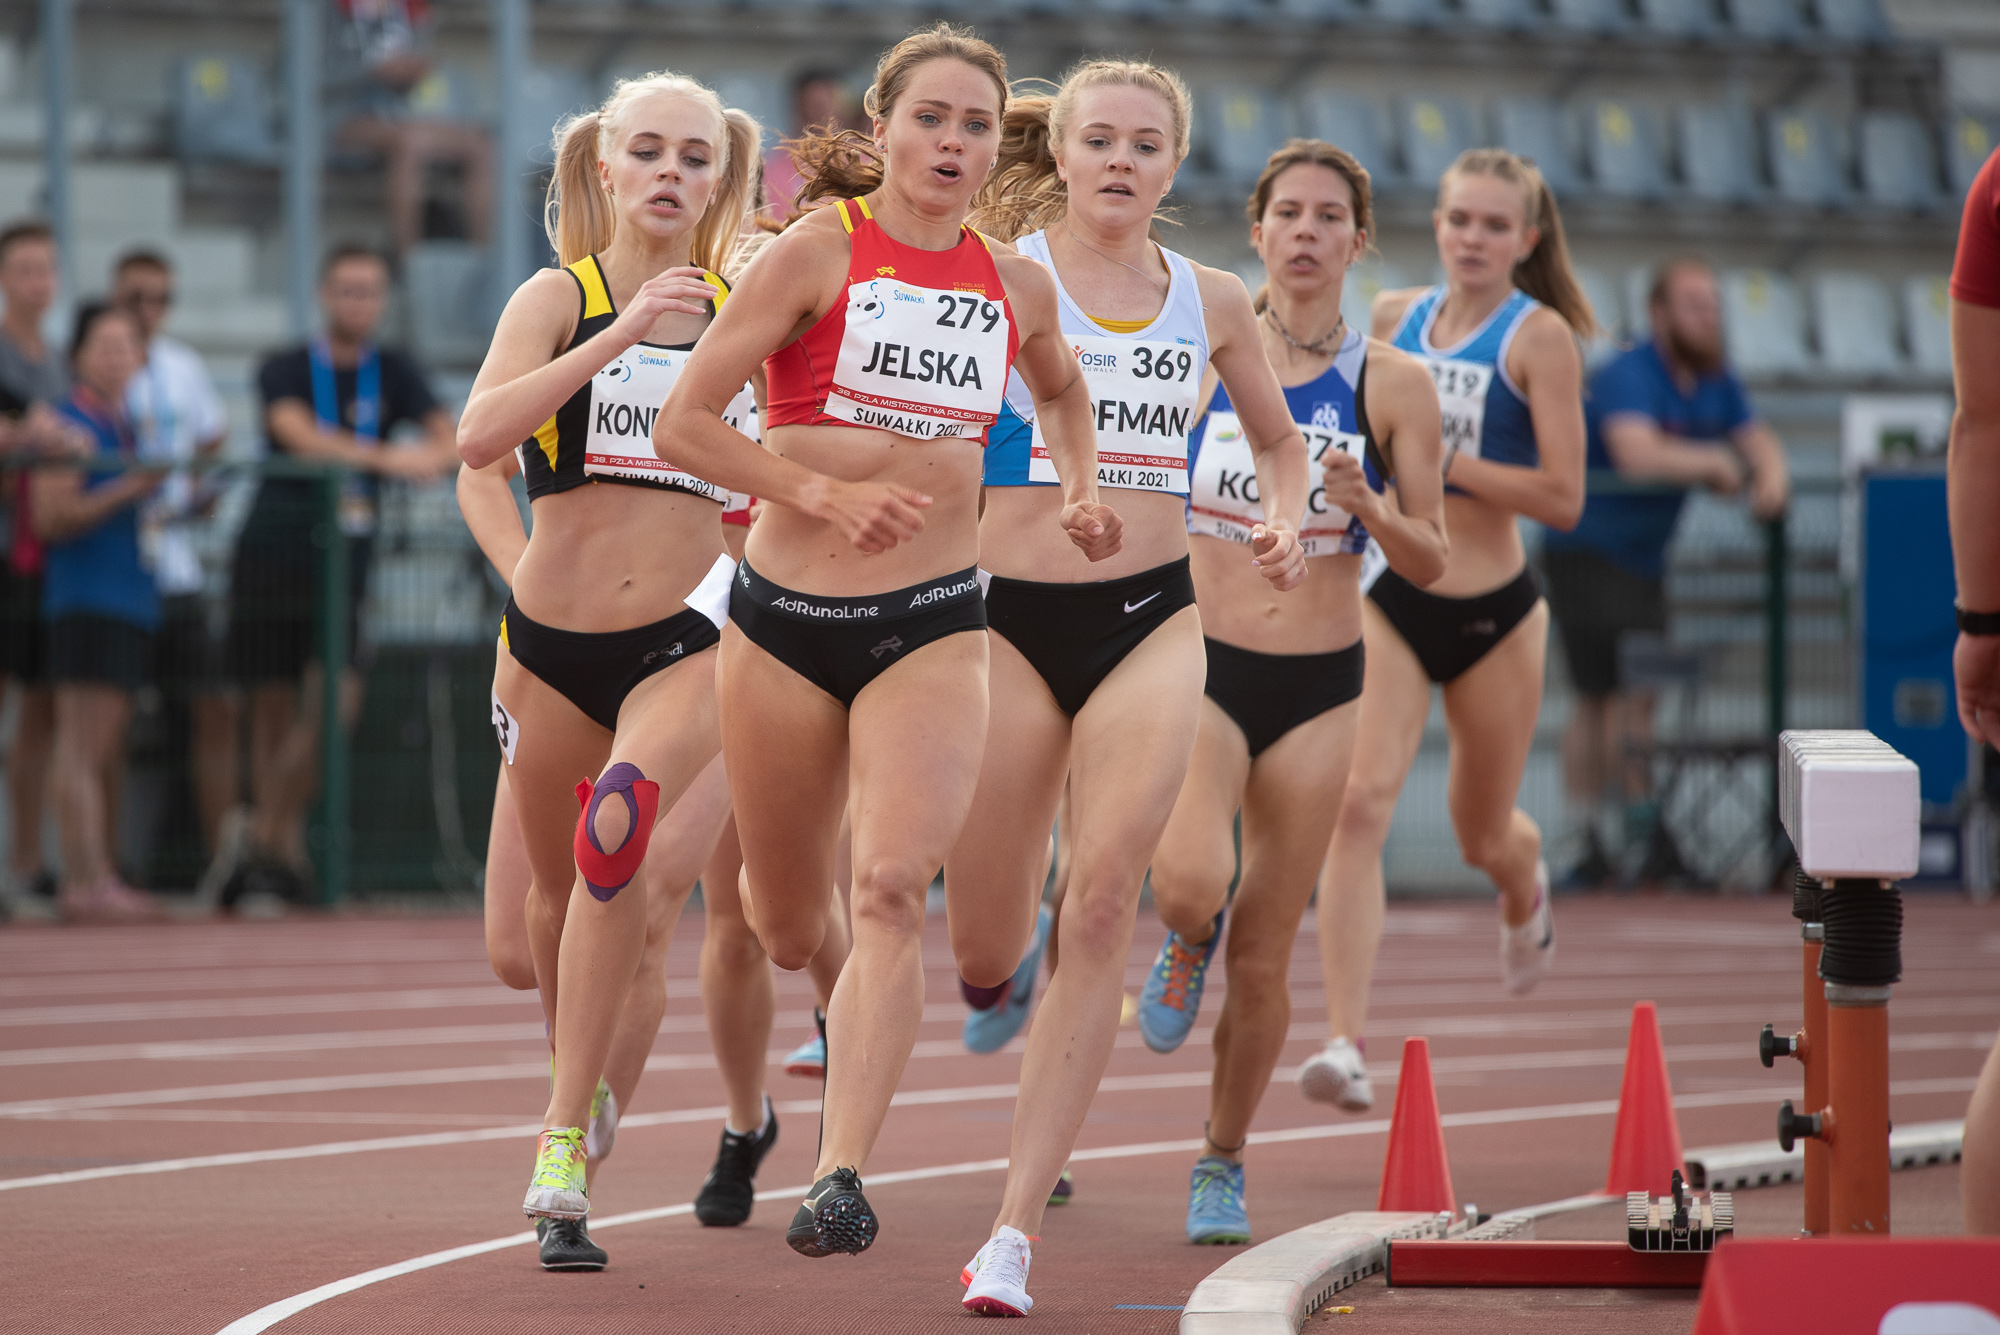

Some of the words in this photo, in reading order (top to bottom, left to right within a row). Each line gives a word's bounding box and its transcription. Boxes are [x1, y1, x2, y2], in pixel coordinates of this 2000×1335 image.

[936, 295, 1000, 333] 279
[861, 341, 983, 391] JELSKA
[1081, 353, 1117, 368] OSIR
[1081, 366, 1117, 374] SUWAŁKI
[1131, 346, 1192, 383] 369
[836, 387, 852, 398] 38.
[853, 393, 879, 405] PZLA
[879, 399, 946, 416] MISTRZOSTWA
[947, 409, 976, 420] POLSKI
[976, 413, 993, 422] U23
[1089, 399, 1190, 438] FMAN
[853, 407, 932, 437] SUWAŁKI
[934, 423, 965, 438] 2021
[592, 455, 608, 464] 38.
[609, 457, 634, 467] PZLA
[1098, 453, 1145, 464] TRZOSTWA
[1146, 458, 1171, 467] POLSKI
[1171, 459, 1184, 468] U23
[1098, 469, 1133, 485] AŁKI
[1137, 471, 1169, 488] 2021
[771, 596, 879, 619] AdRunaLine
[908, 575, 979, 609] AdRunaL
